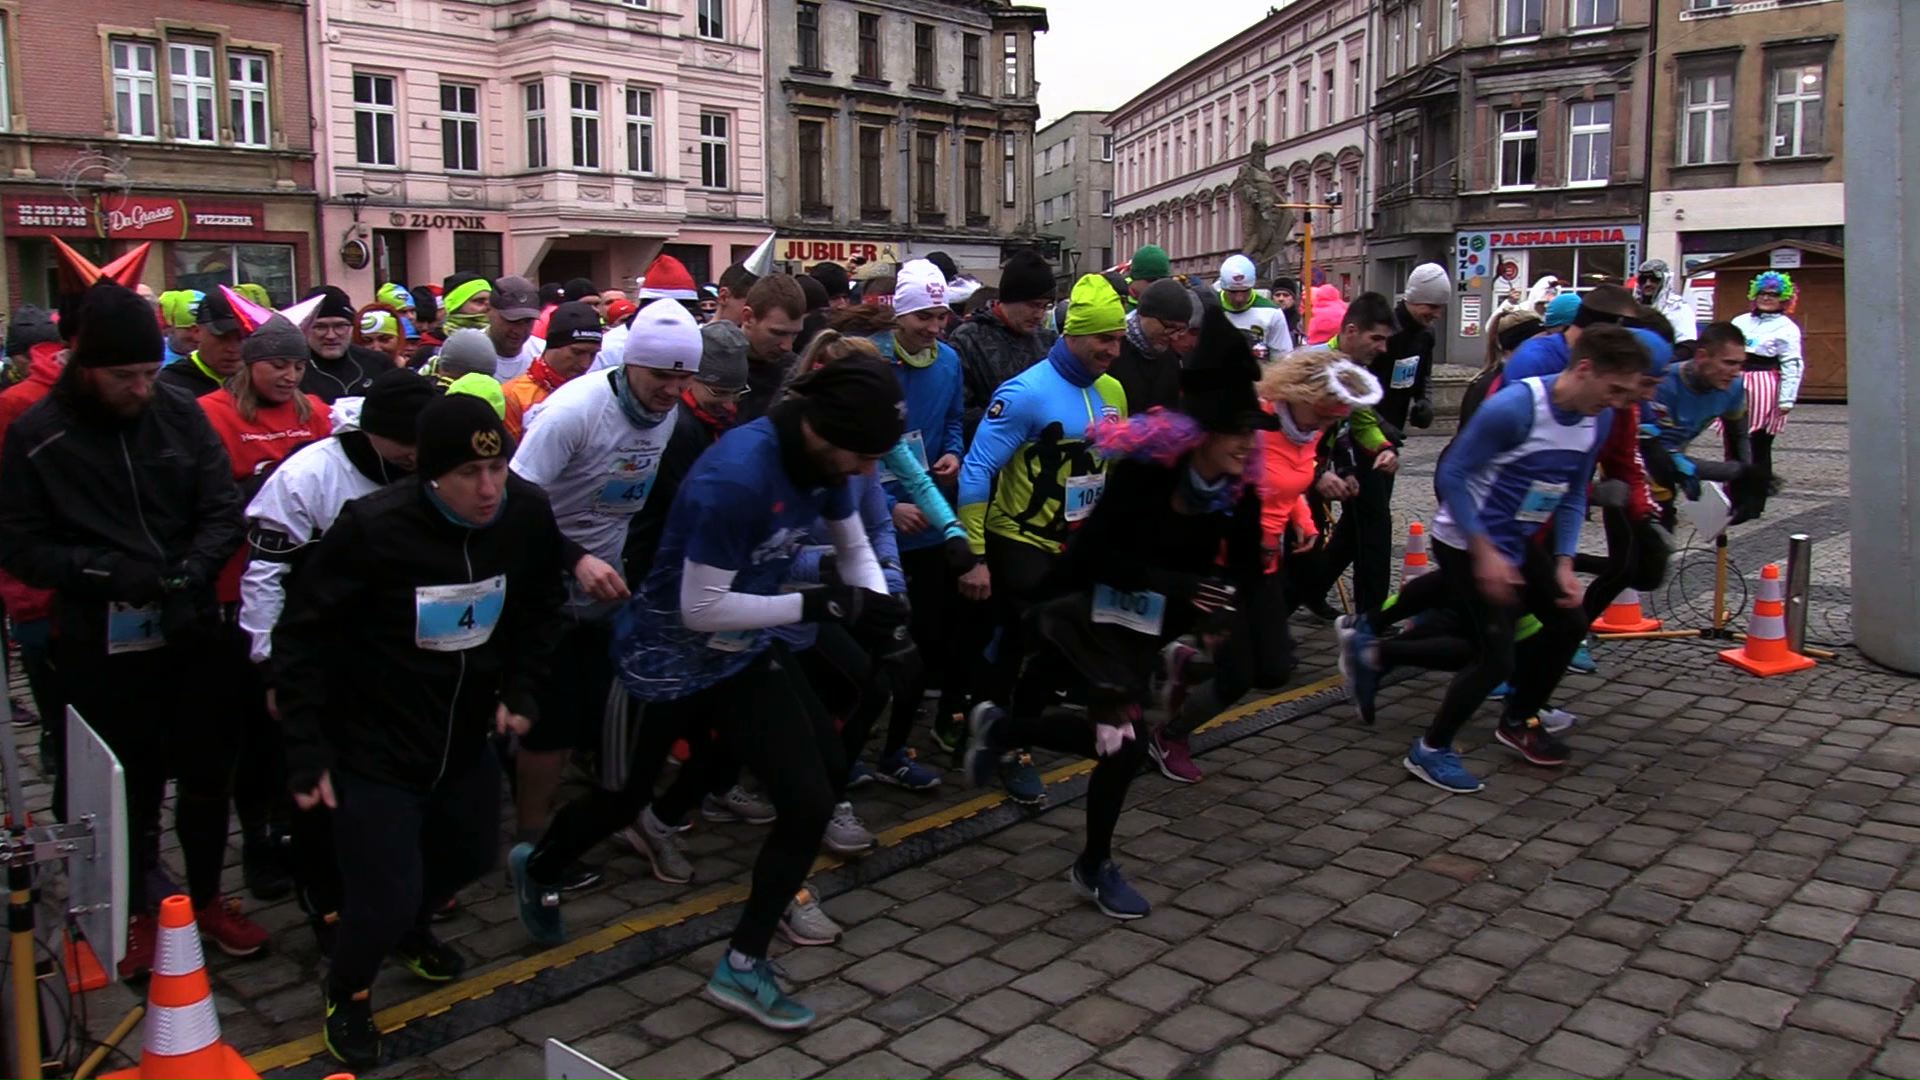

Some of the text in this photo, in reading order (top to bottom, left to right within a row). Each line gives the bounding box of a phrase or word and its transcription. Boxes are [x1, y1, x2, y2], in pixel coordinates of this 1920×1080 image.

[18, 205, 33, 214] 32
[195, 213, 253, 226] PIZZERIA
[411, 213, 486, 230] ZŁOTNIK
[1489, 228, 1625, 247] PASMANTERIA
[784, 241, 878, 262] JUBILER
[1458, 237, 1468, 292] GUZIK
[621, 482, 646, 501] 43
[458, 603, 476, 630] 4
